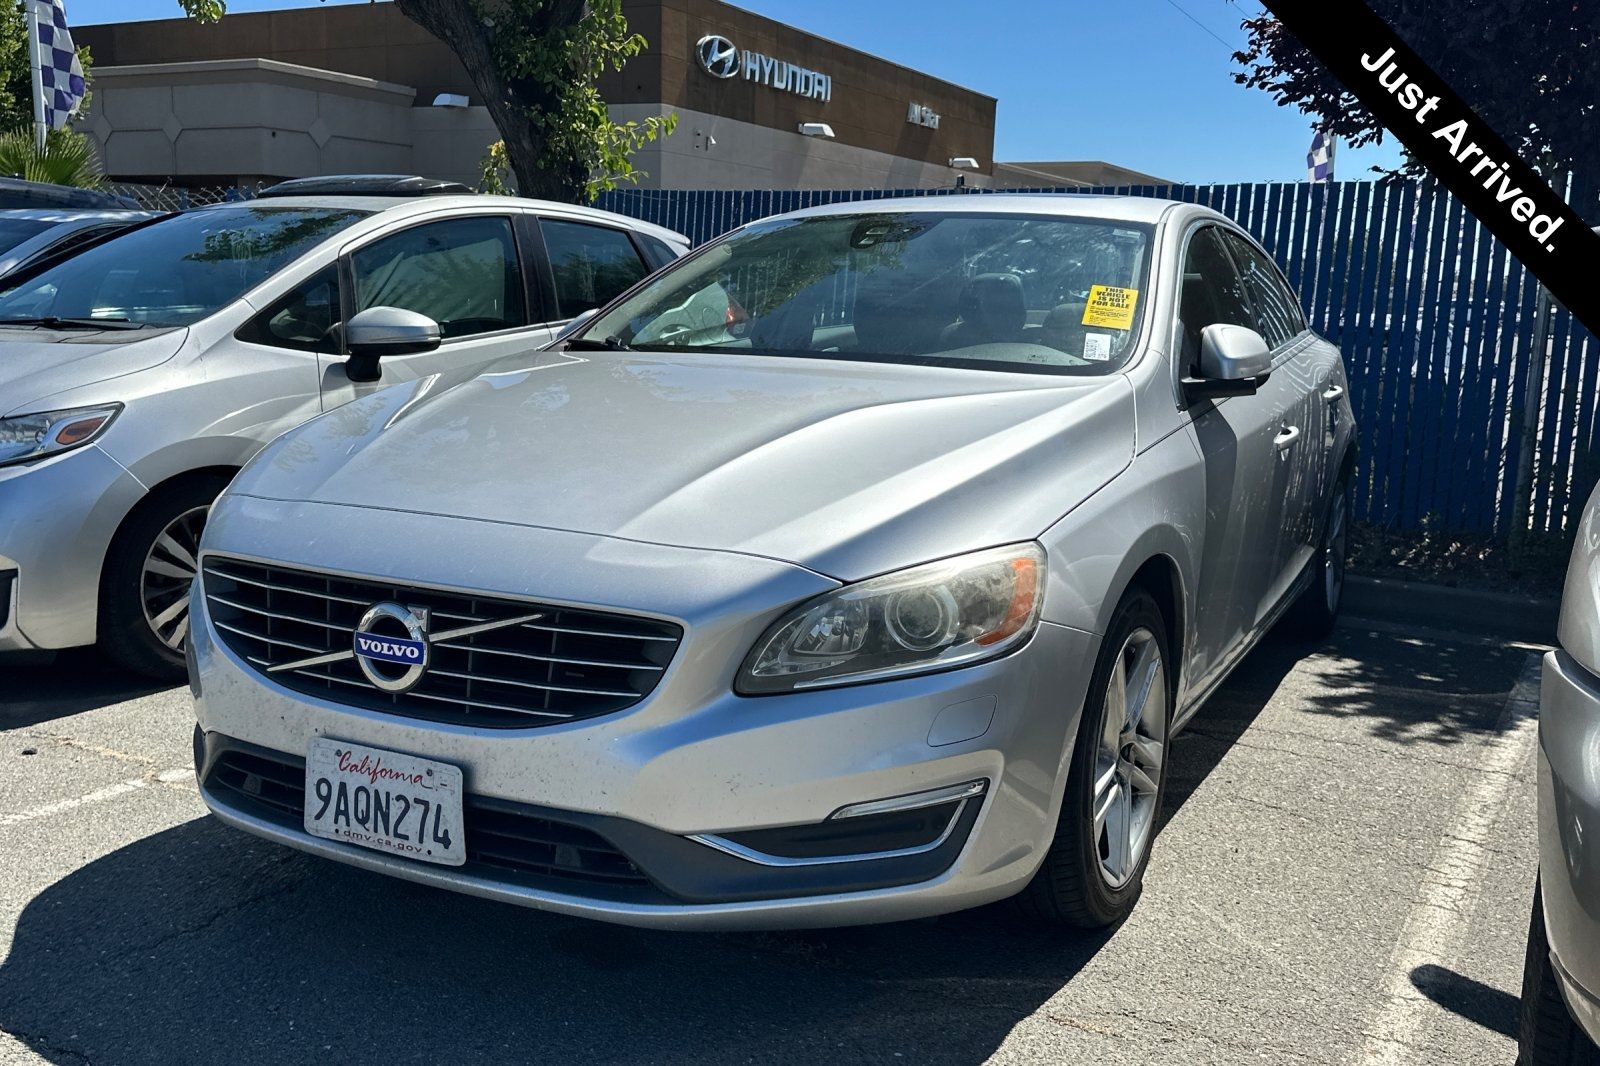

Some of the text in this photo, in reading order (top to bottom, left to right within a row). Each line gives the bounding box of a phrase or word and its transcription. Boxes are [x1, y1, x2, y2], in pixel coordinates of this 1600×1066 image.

[742, 50, 832, 102] HYUNDAI
[1096, 291, 1130, 299] VEHICLE
[357, 637, 420, 659] VOLVO
[338, 751, 433, 789] California
[314, 777, 452, 850] 9AQN274
[343, 830, 423, 853] dmv.ca.gov
